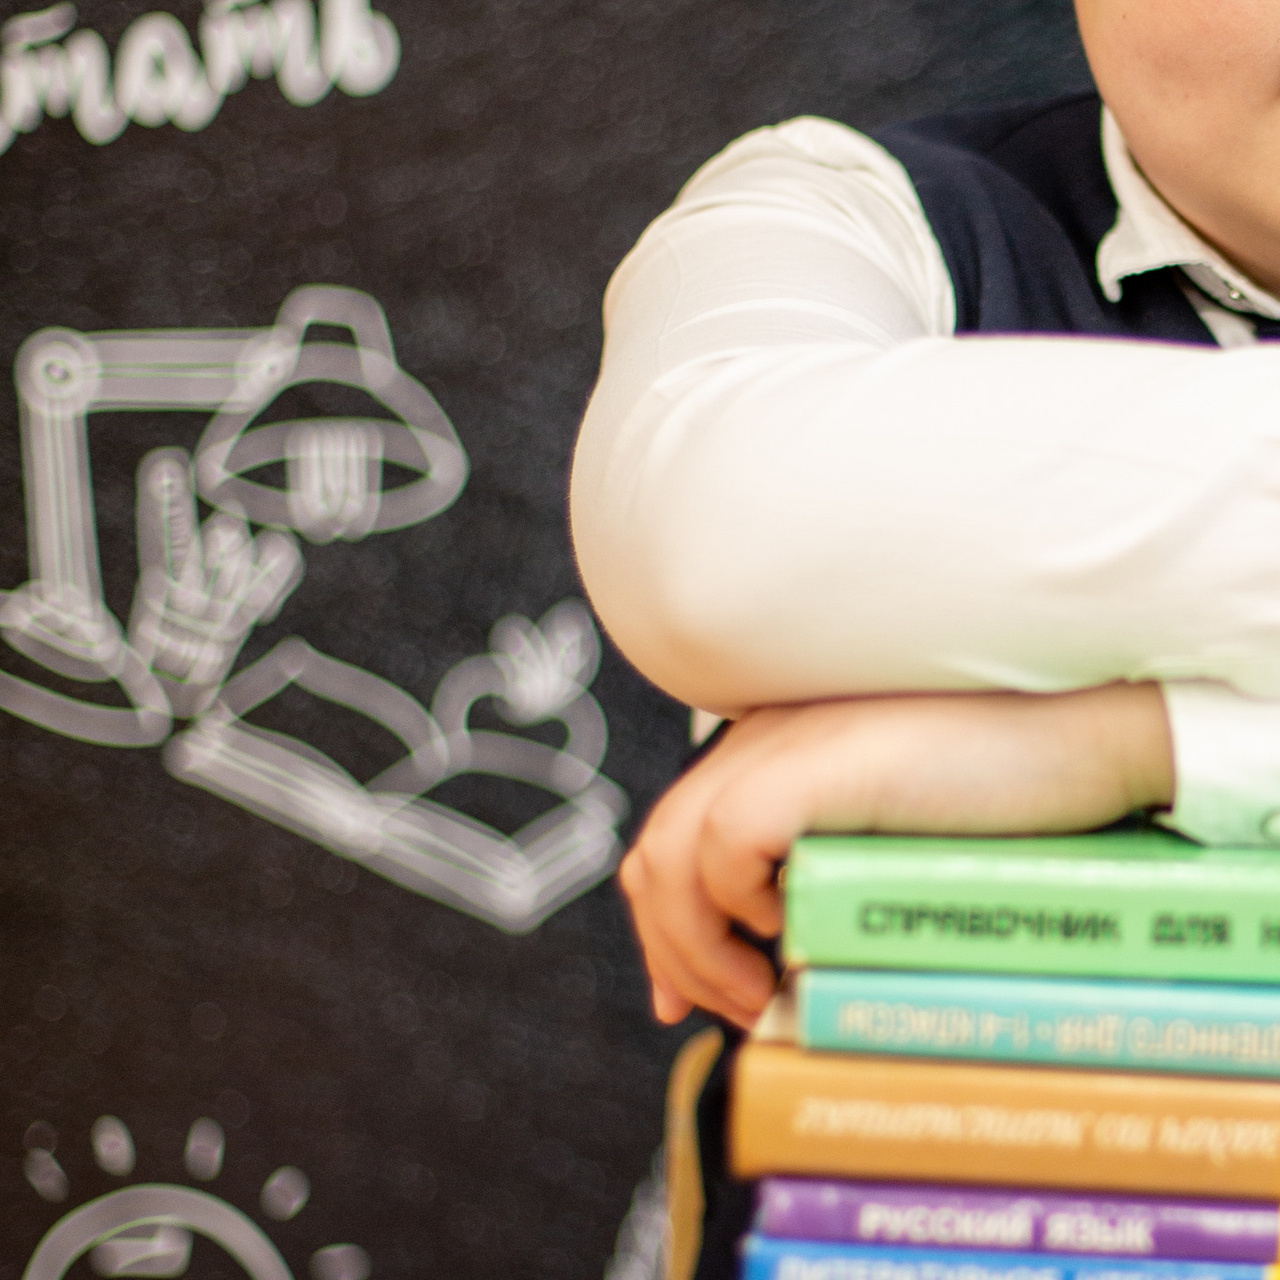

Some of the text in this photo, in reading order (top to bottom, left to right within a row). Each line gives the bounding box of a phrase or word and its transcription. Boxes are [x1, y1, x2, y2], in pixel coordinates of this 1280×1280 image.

[857, 900, 1122, 946] СПРАВОЧНИК
[1151, 910, 1232, 949] ДЛЯ
[838, 998, 973, 1047] КЛАССЫ
[1056, 1012, 1125, 1055] ДНЯ
[794, 1094, 1087, 1150] математике
[1093, 1113, 1152, 1153] по
[856, 1197, 1155, 1254] РУССКИЙ ЯЗЫК
